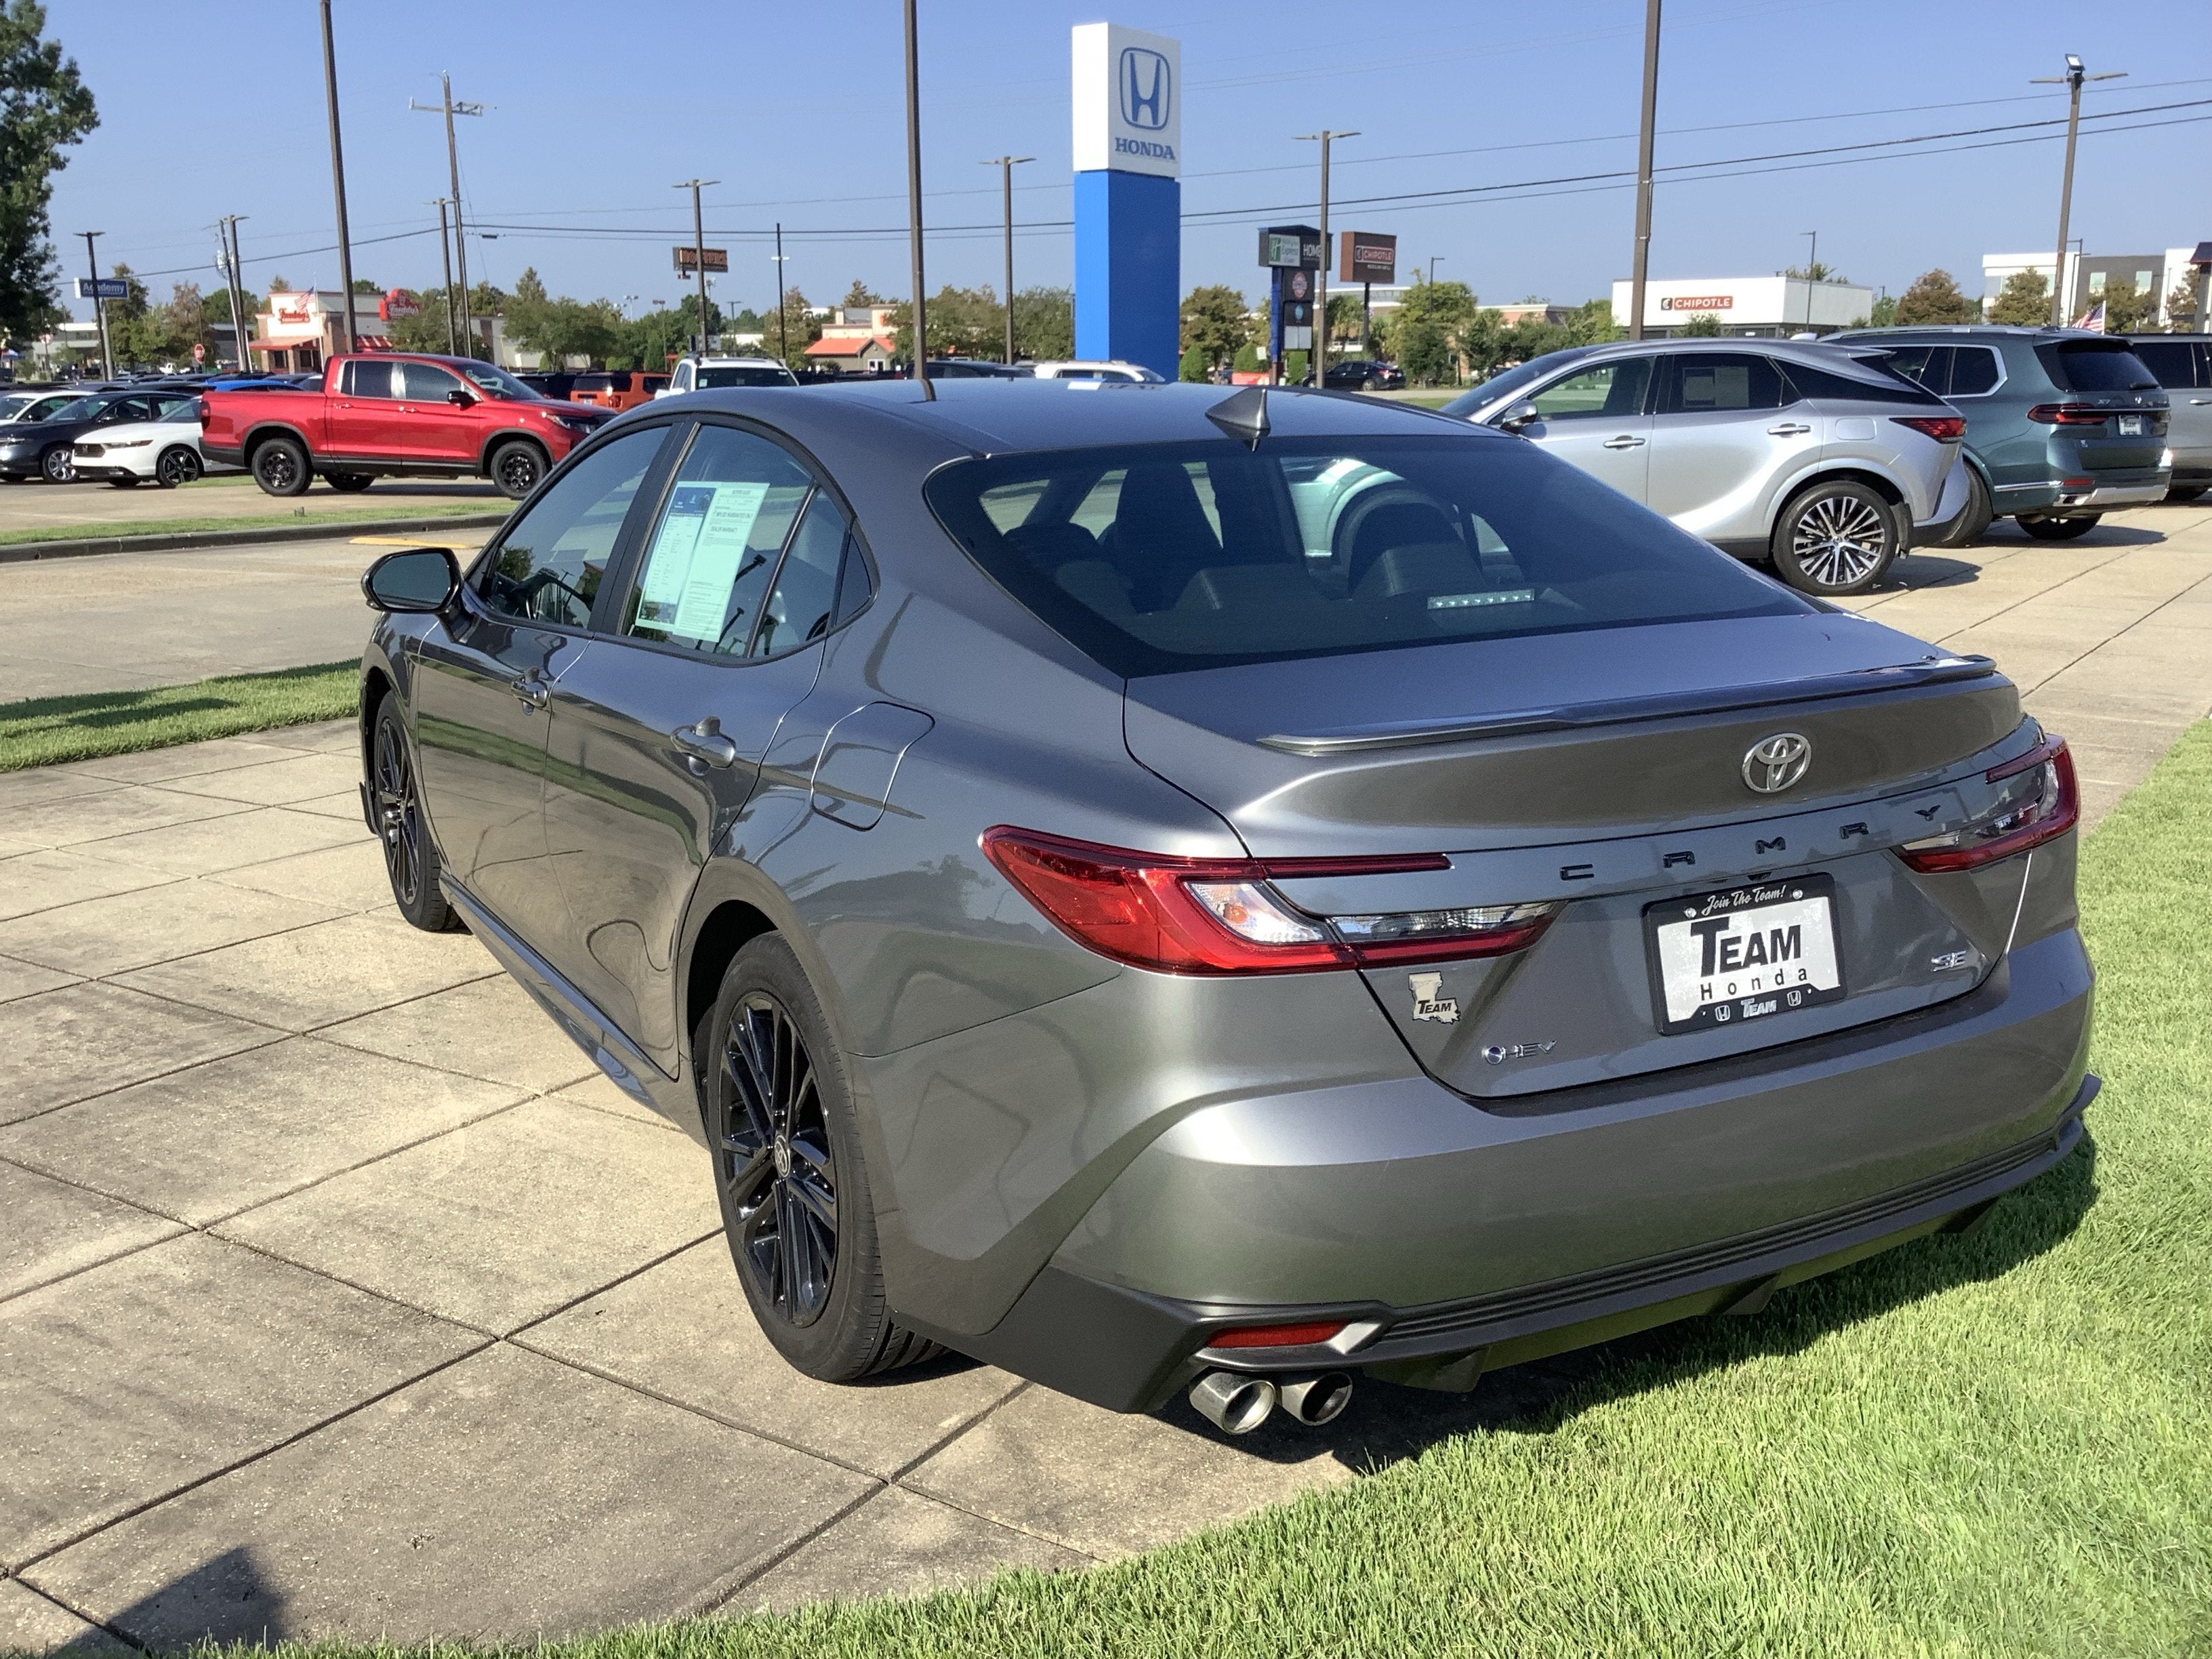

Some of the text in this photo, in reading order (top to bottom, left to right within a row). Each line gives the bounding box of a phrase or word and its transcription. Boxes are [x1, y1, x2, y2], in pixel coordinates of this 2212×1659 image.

[1115, 137, 1176, 161] HONDA
[1364, 250, 1392, 261] CHIPOTLE
[1675, 298, 1731, 308] CHIPOTLE
[1559, 804, 1941, 880] CAMRY
[1701, 885, 1786, 916] Join The Team!
[1690, 916, 1801, 978] TEAM
[1930, 950, 1967, 972] SE
[1700, 968, 1807, 1001] Honda
[1418, 999, 1452, 1015] TEAM
[1740, 998, 1777, 1018] TEAM
